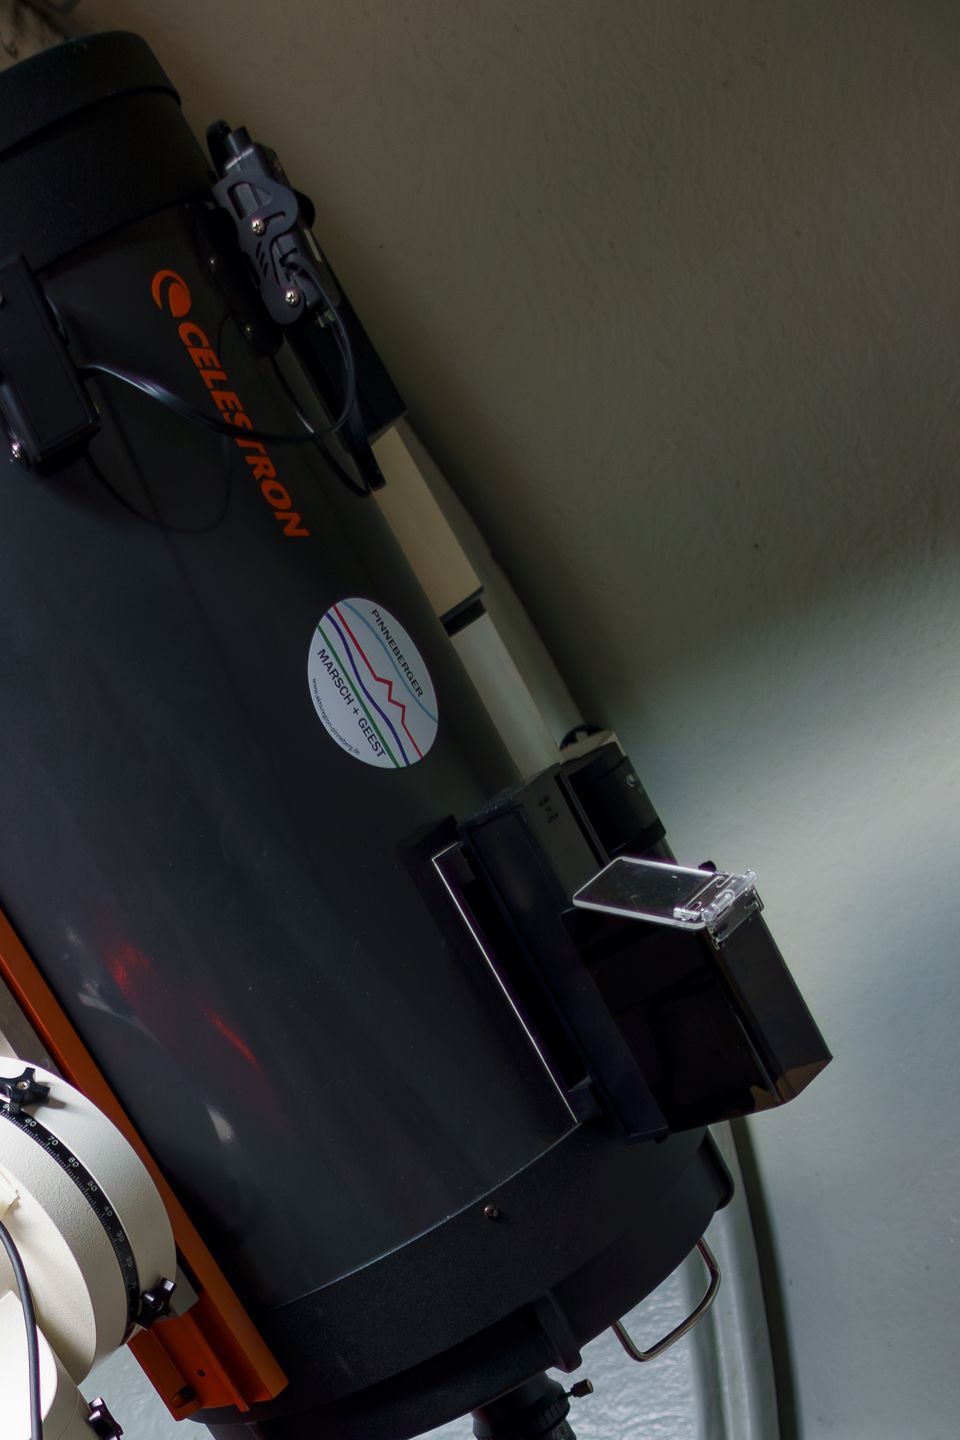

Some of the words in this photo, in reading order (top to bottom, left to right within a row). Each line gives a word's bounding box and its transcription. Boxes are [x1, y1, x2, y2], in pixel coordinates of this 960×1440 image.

[317, 649, 354, 705] MARSCH
[358, 718, 386, 757] GEEST
[371, 608, 424, 697] PINNEBERGER
[24, 1117, 37, 1128] 80
[47, 1135, 58, 1147] 70
[68, 1156, 79, 1169] 60
[87, 1181, 98, 1192] 50
[103, 1206, 113, 1217] 40
[116, 1230, 125, 1242] 30
[126, 1256, 133, 1267] 20
